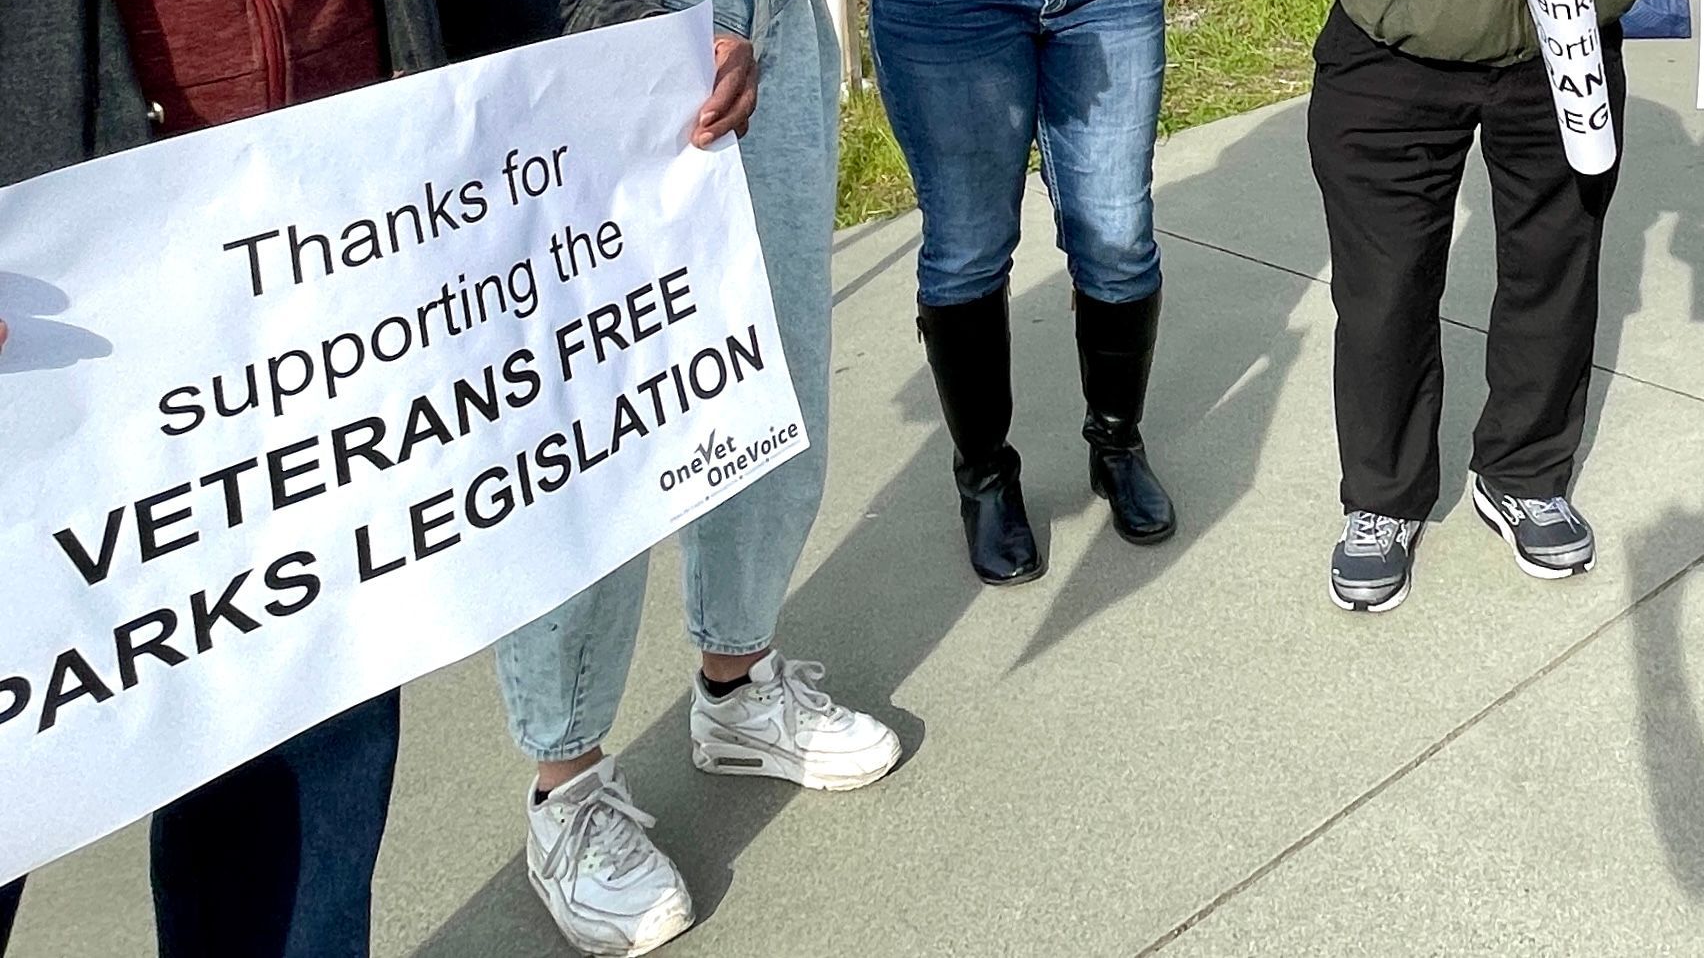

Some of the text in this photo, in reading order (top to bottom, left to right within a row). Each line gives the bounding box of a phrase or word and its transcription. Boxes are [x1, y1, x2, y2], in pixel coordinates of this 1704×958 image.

[224, 145, 568, 297] Thanks for
[160, 217, 624, 436] supporting the
[53, 349, 542, 586] VETERANS
[555, 268, 697, 381] FREE
[356, 325, 765, 582] LEGISLATION
[660, 428, 736, 491] OneVet
[707, 423, 798, 487] OneVoice
